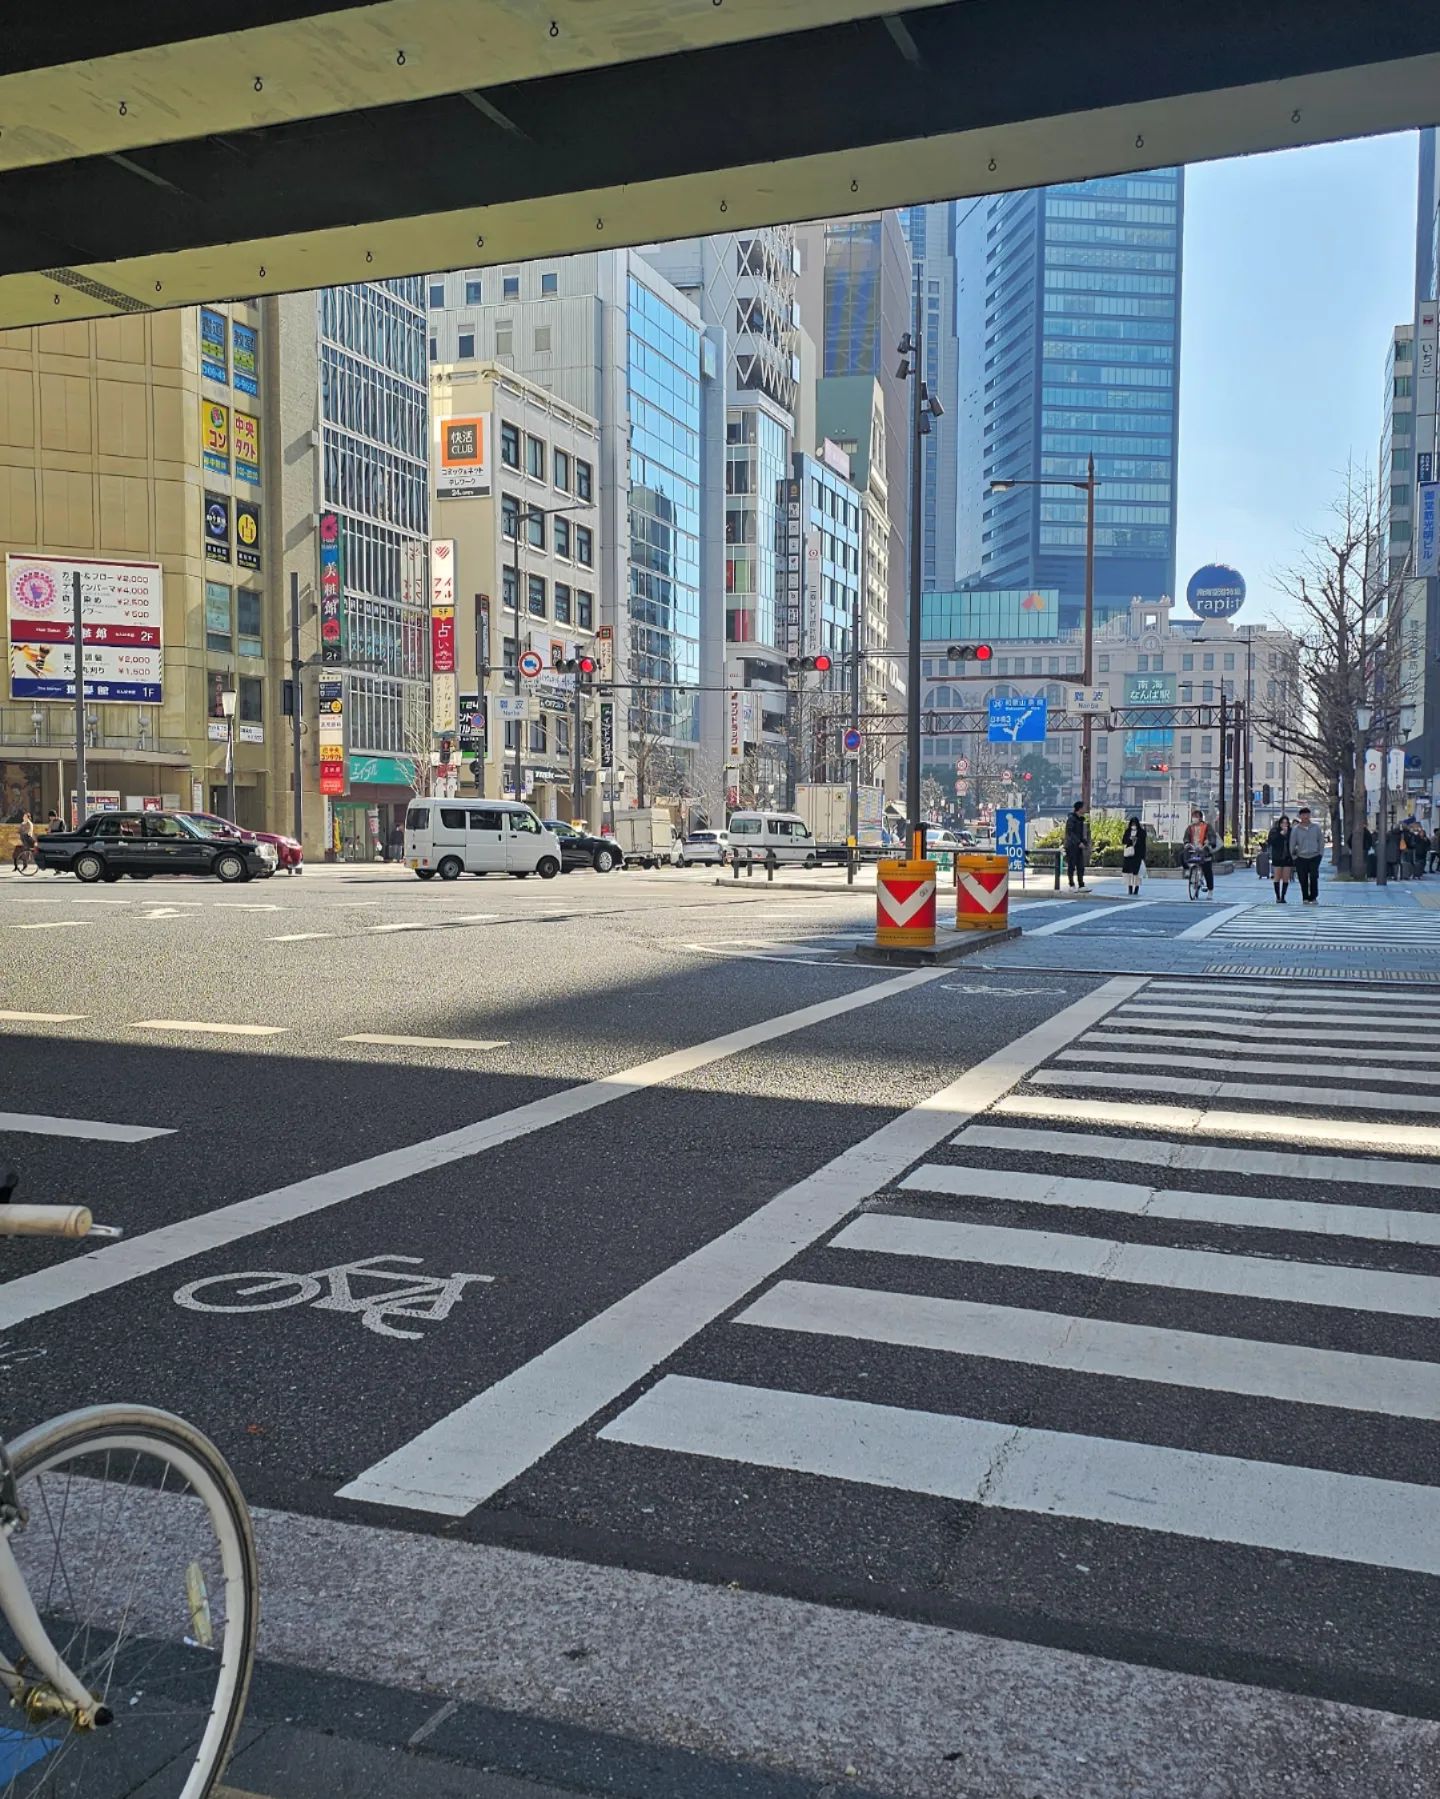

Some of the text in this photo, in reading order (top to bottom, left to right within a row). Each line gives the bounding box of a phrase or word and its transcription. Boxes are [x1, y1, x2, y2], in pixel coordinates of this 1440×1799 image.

[235, 416, 254, 438] 中央
[451, 431, 473, 443] 快活
[452, 444, 473, 454] CLUB
[62, 594, 102, 604] 白染め
[1197, 597, 1241, 613] rapi:t
[141, 631, 154, 641] 2F
[437, 623, 452, 650] 占い
[1138, 680, 1163, 689] 南海
[143, 687, 155, 697] 1F
[1130, 690, 1170, 700] なんば駅
[1004, 846, 1023, 858] 100
